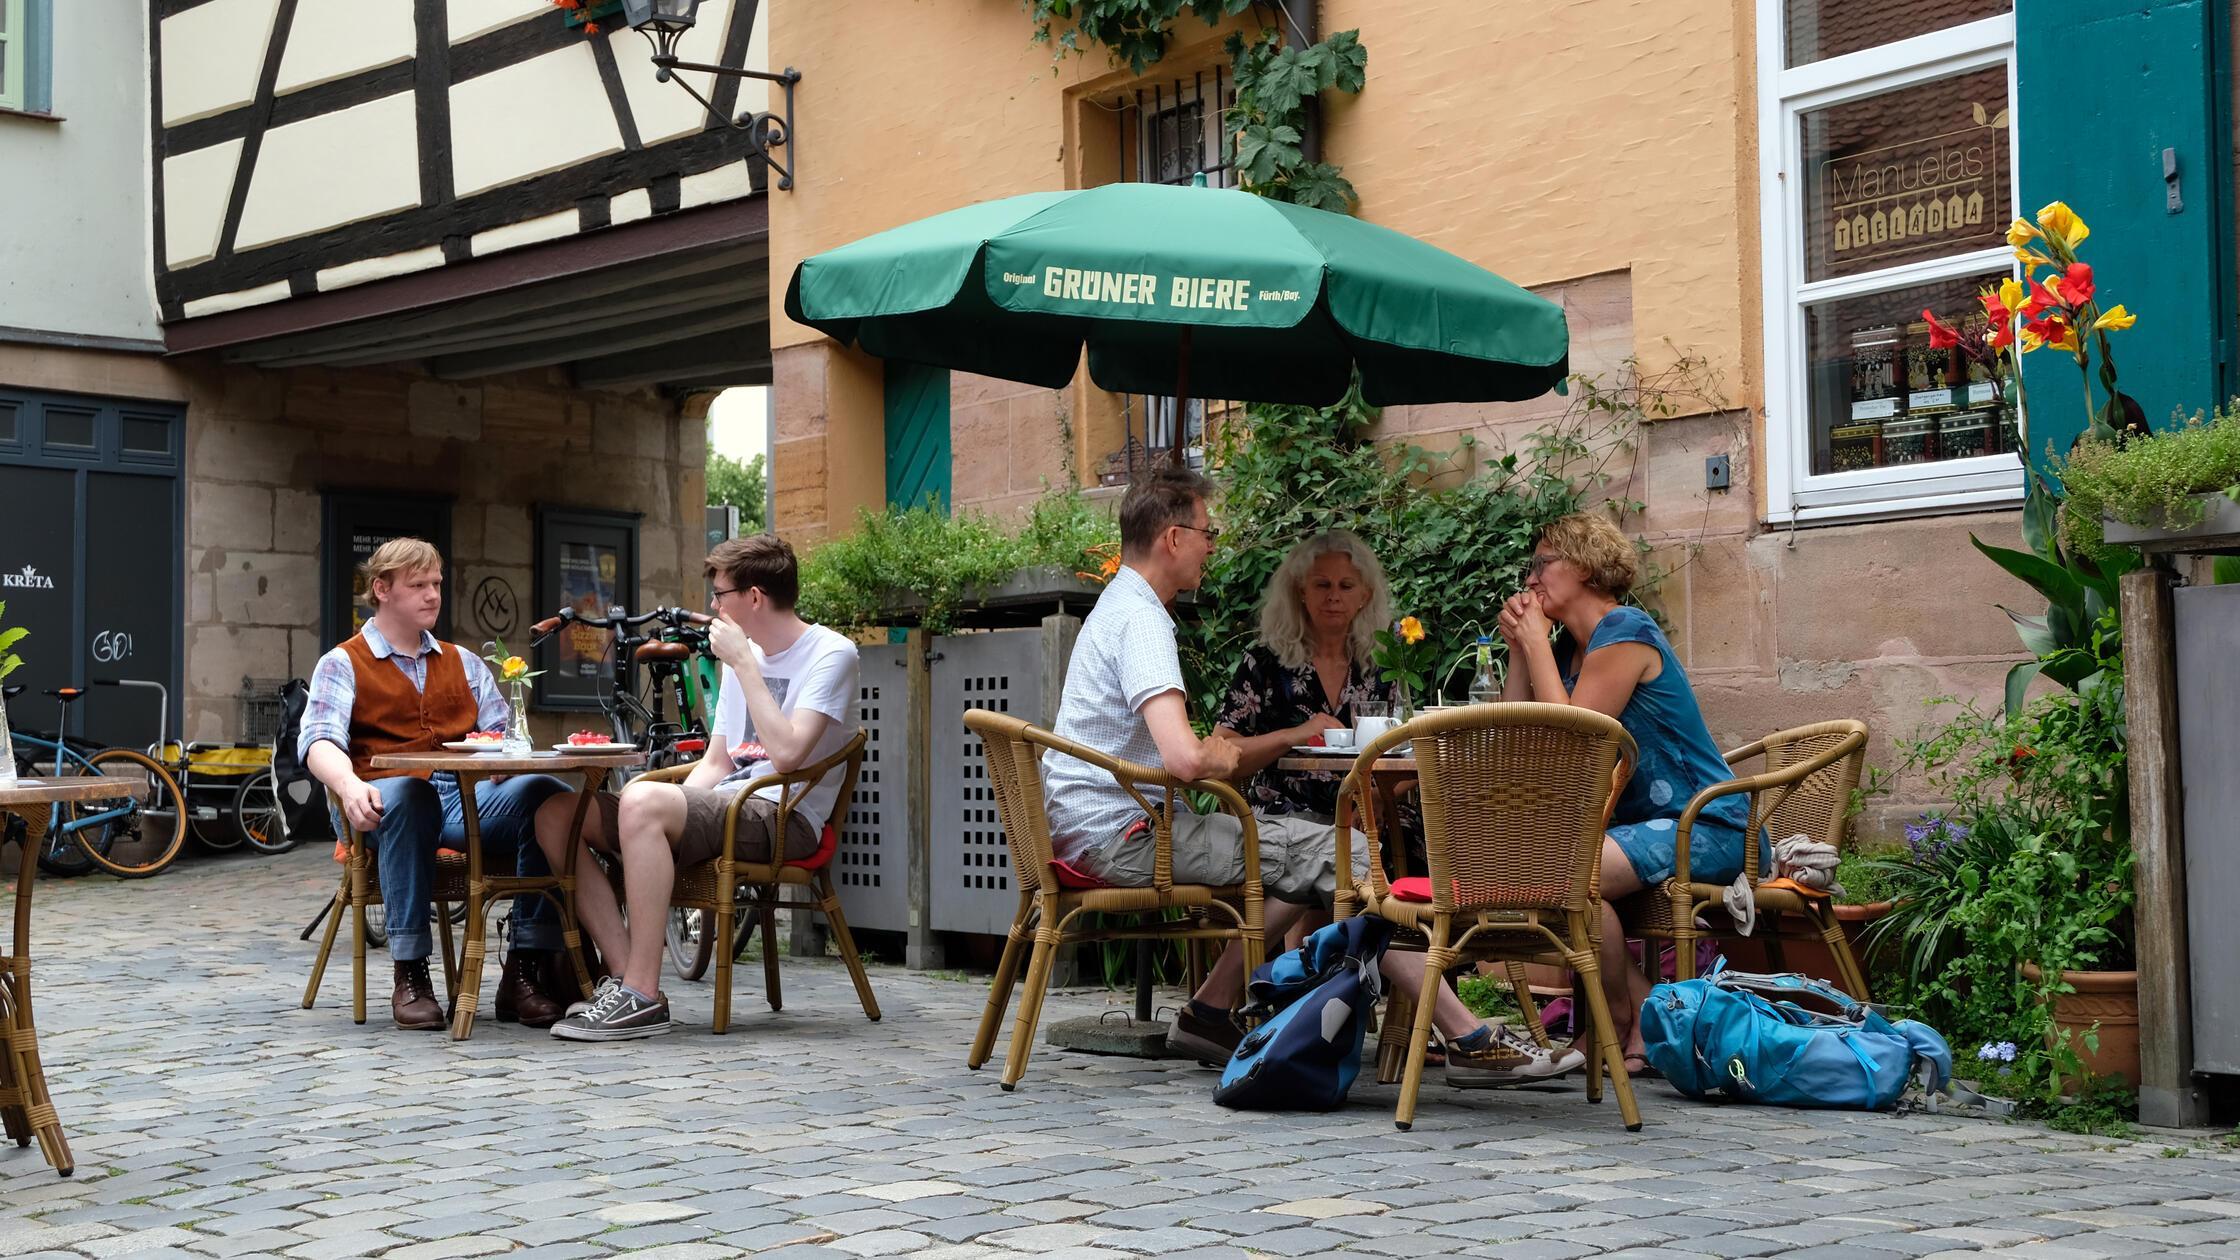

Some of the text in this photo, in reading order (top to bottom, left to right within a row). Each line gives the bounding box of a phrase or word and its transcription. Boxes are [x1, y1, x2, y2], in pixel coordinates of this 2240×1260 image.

[1833, 146, 1984, 204] Manuelas
[1837, 200, 1979, 247] TEELÄDLA
[1003, 266, 1301, 311] Original GRÜNER BIERE Fürth/Bay.
[3, 574, 54, 588] KRETA
[704, 693, 716, 717] Bolt
